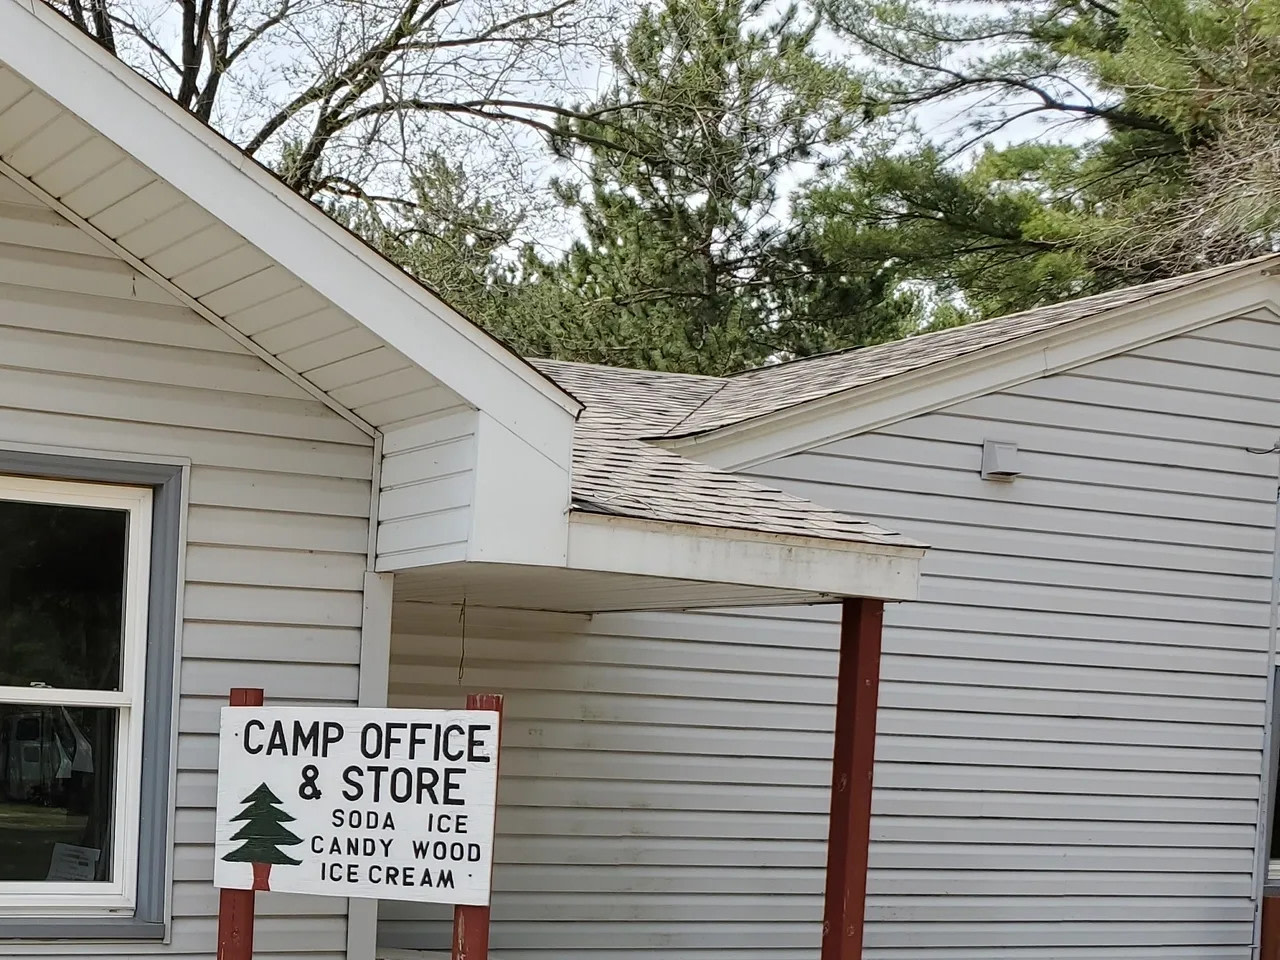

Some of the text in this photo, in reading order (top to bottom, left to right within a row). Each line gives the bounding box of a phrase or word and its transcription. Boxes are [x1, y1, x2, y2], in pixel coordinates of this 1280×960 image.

[243, 719, 491, 762] CAMP OFFICE
[298, 764, 466, 805] & STORE
[331, 808, 468, 834] SODA ICE
[311, 835, 481, 862] CANDY WOOD
[321, 862, 455, 889] ICE CREAM
